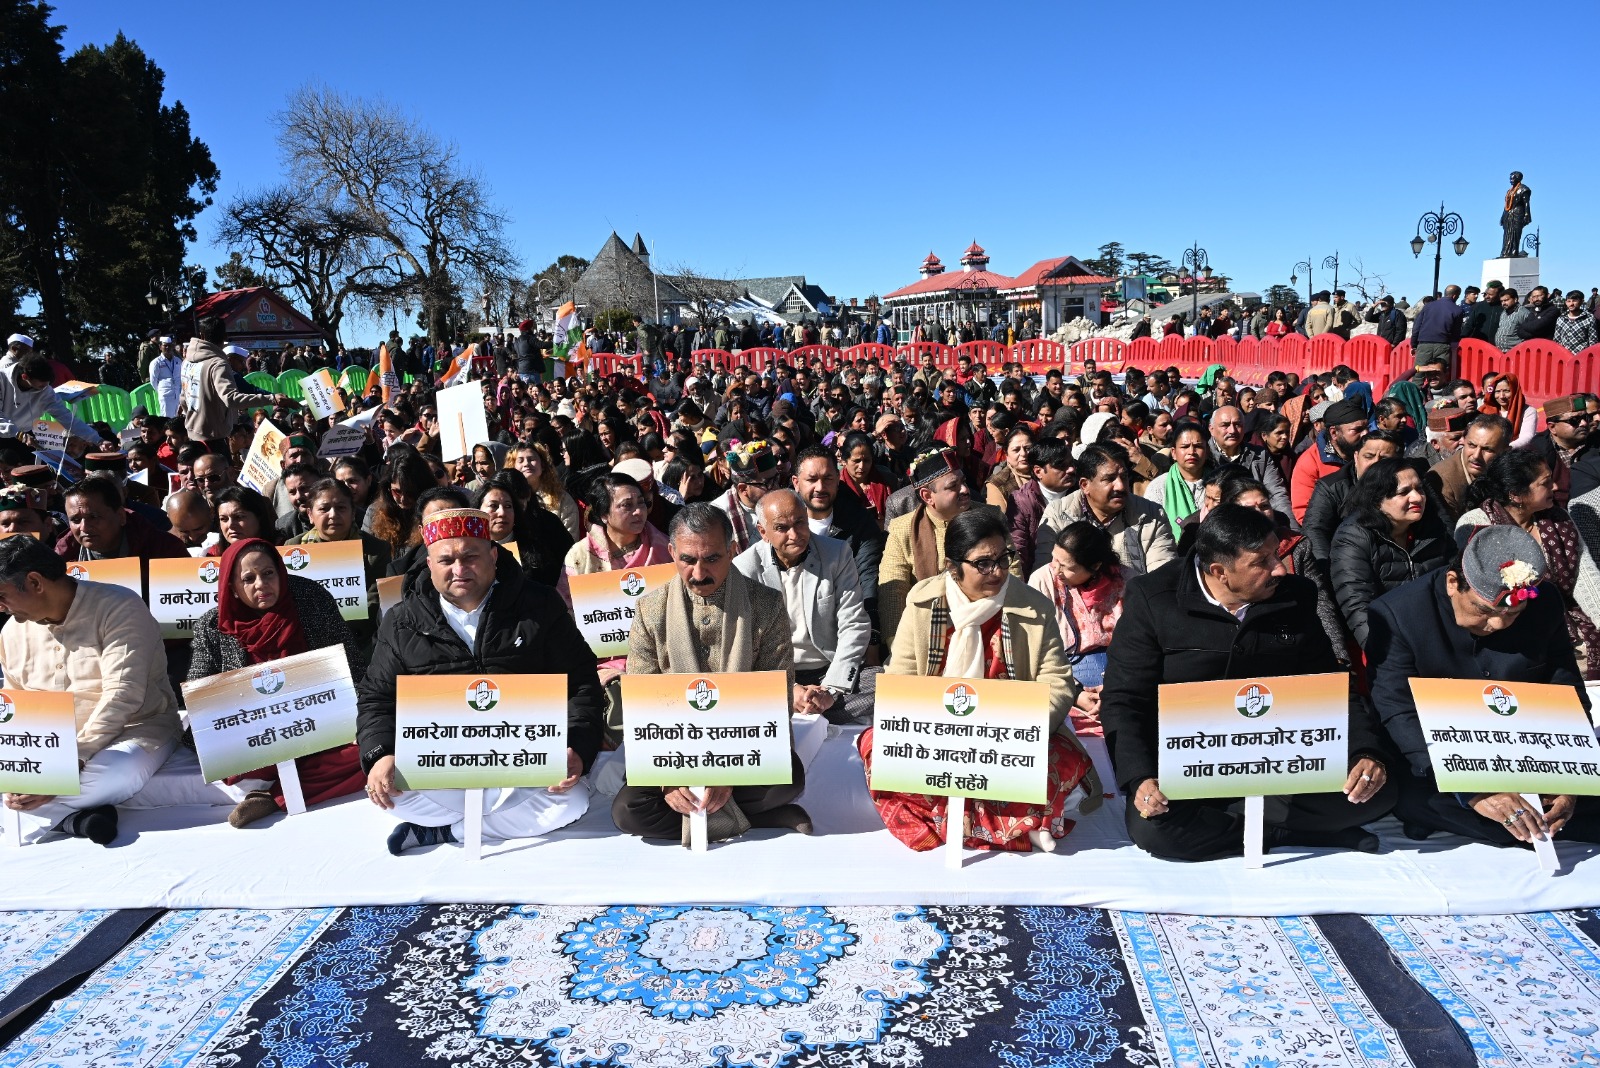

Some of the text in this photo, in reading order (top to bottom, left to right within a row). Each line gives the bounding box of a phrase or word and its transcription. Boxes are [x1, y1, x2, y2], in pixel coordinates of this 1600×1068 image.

[332, 578, 344, 587] पर
[346, 576, 360, 586] वार
[160, 589, 210, 605] मनरेगा
[345, 597, 359, 607] वार
[583, 607, 622, 625] श्रमिकों
[213, 689, 336, 730] मनरेगा पर हमला
[247, 717, 316, 748] नहीं सहेंगे
[403, 721, 561, 740] मनरेगा कमज़ोर हुआ,
[634, 721, 777, 740] श्रमिकों के सम्मान में
[880, 716, 1041, 742] गांधी पर हमला मंजूर नहीं
[1166, 727, 1341, 750] मनरेगा कमज़ोर हुआ,
[1430, 726, 1593, 749] मनरेगा पर वार, मजदूर पर वार
[45, 732, 60, 748] तो
[417, 749, 547, 767] गांव कमजोर होगा
[653, 750, 761, 769] कांग्रेस मैदान में
[883, 743, 913, 759] गांधी
[916, 744, 930, 760] के
[980, 749, 998, 764] की
[1001, 753, 1035, 768] हत्या
[1442, 754, 1600, 776] संविधान और अधिकार पर वार
[1183, 755, 1326, 777] गांव कमजोर होगा
[926, 772, 988, 791] नहीं सहेंगे
